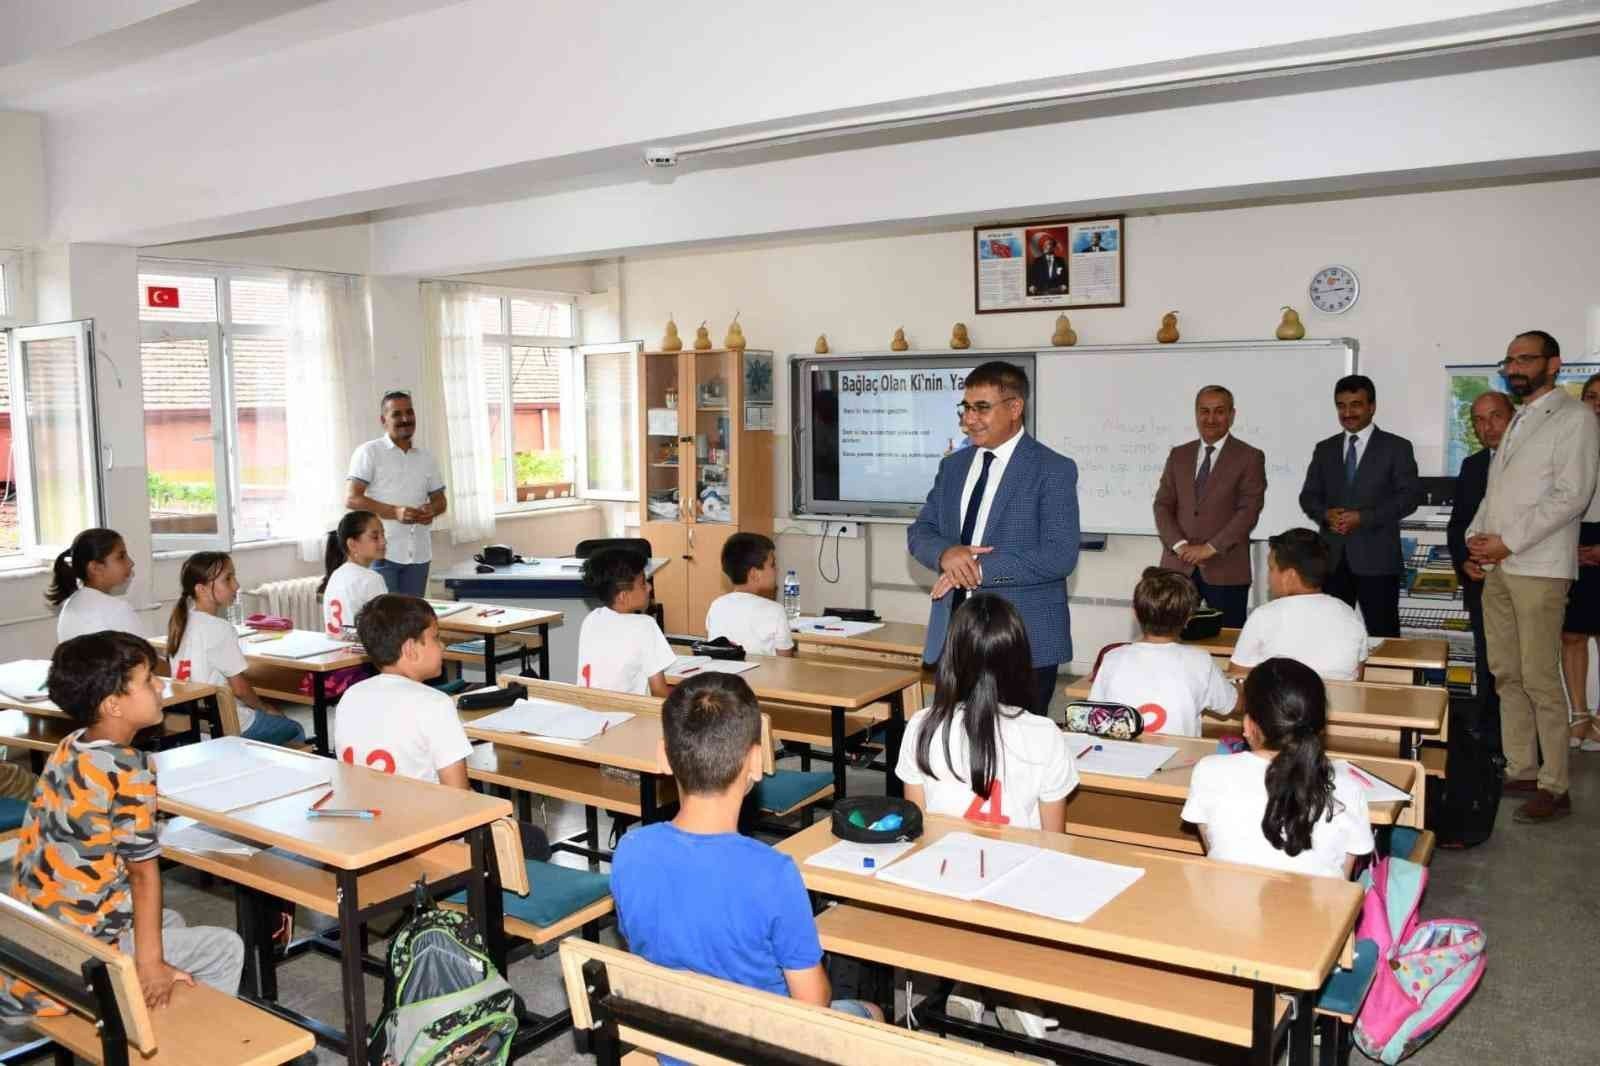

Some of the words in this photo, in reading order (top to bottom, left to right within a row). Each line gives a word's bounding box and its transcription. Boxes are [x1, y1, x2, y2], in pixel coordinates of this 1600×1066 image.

[842, 375, 878, 396] Bağlaç
[881, 374, 907, 391] Olan
[950, 373, 967, 391] Ya
[327, 599, 343, 634] 3
[963, 778, 1010, 824] 4
